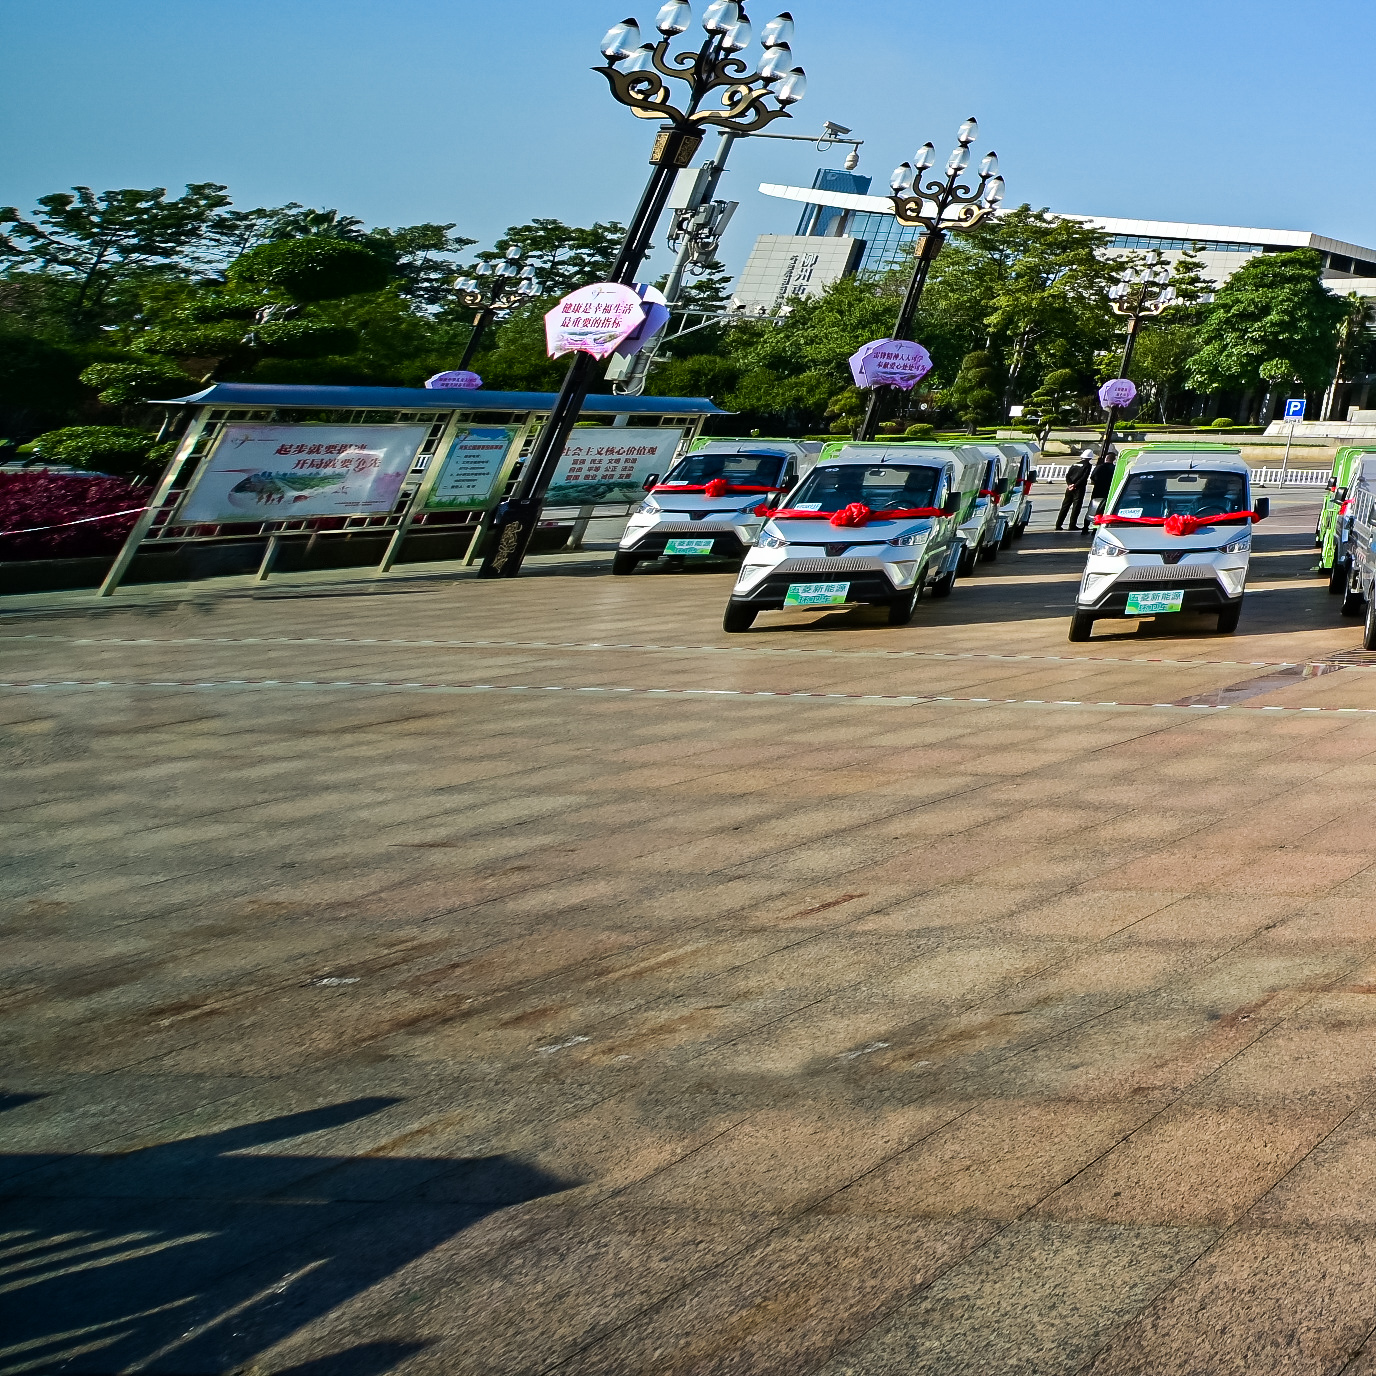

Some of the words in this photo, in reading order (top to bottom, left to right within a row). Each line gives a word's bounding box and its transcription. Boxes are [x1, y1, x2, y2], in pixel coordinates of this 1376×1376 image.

[561, 302, 634, 315] 健康是幸福生活
[560, 316, 623, 329] 最重要的指标
[1289, 401, 1301, 416] P
[561, 446, 658, 457] 社会主义核心价值观
[292, 457, 382, 472] 开局就要争先
[789, 584, 848, 593] 五菱新能源
[1129, 592, 1182, 602] 五菱新能源
